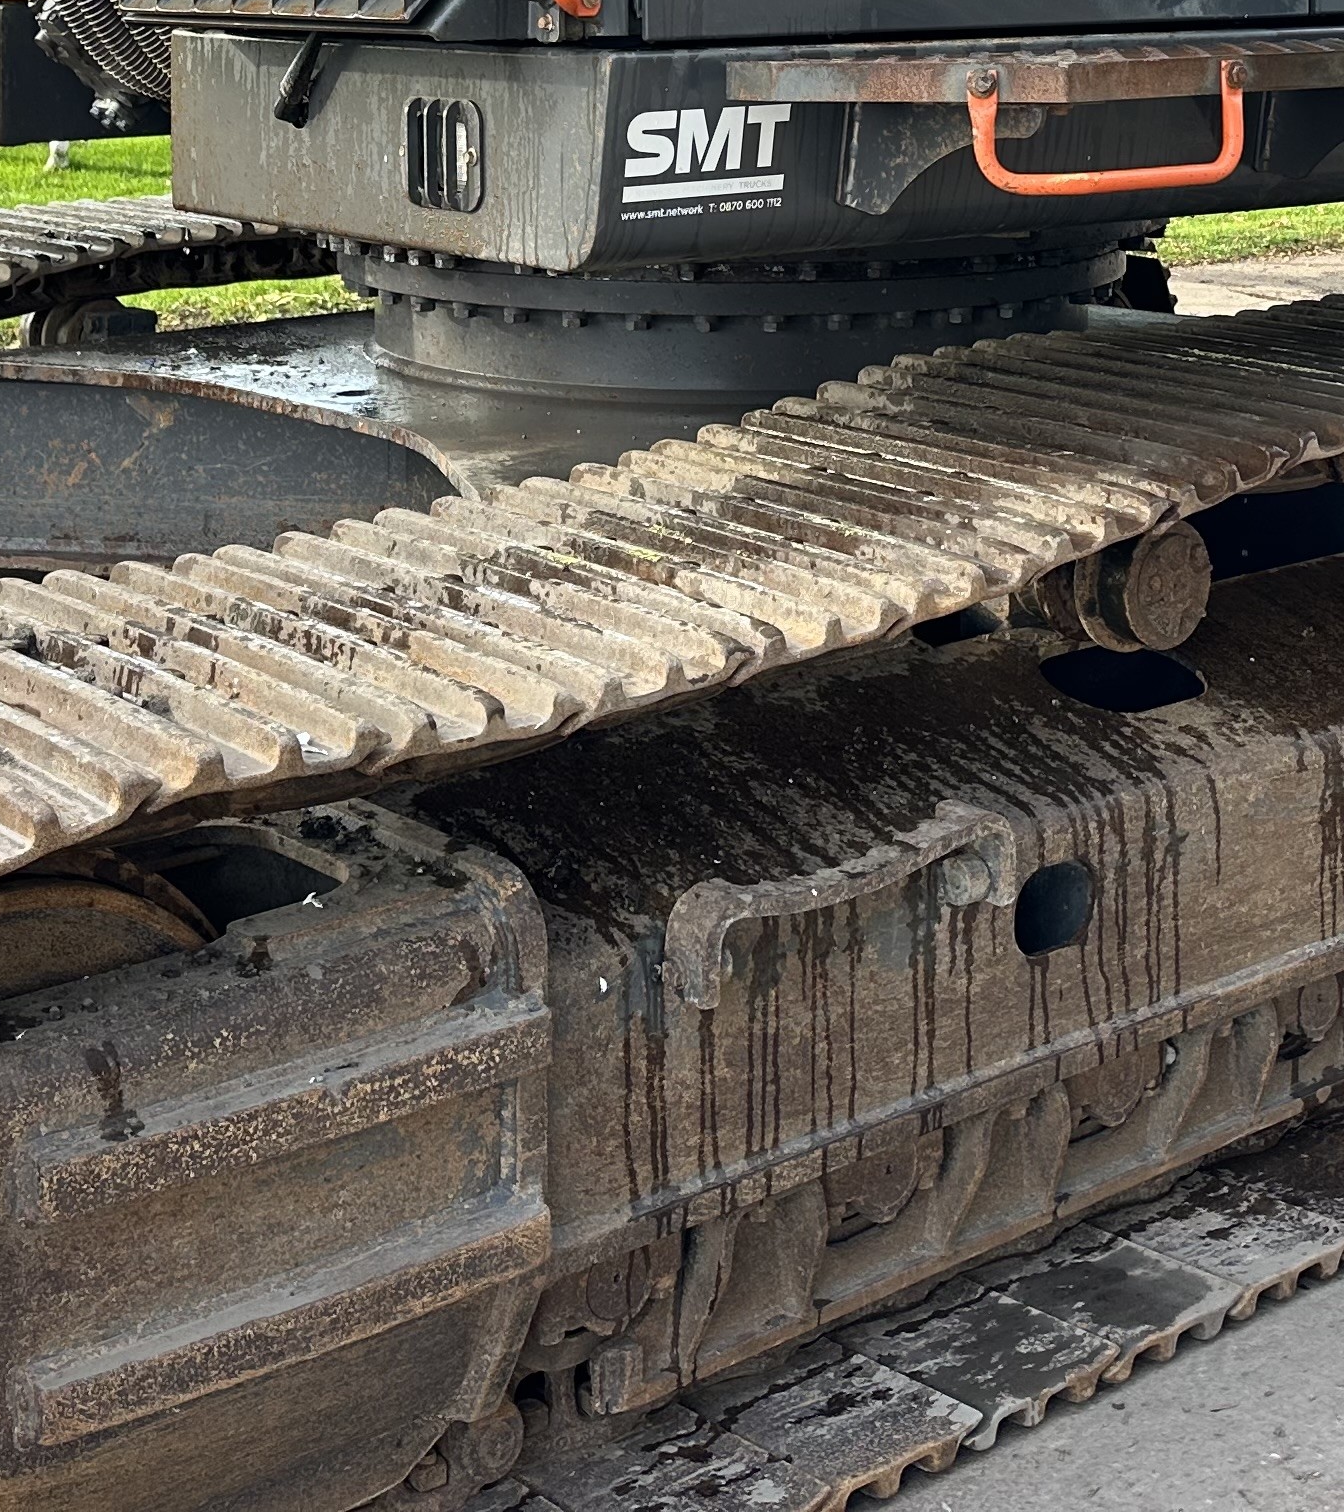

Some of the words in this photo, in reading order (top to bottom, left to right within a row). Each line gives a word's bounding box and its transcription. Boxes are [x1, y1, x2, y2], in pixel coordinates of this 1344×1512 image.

[624, 103, 791, 178] SMT
[621, 204, 704, 220] www.smt.network
[719, 201, 742, 212] 0870
[745, 199, 764, 210] 600
